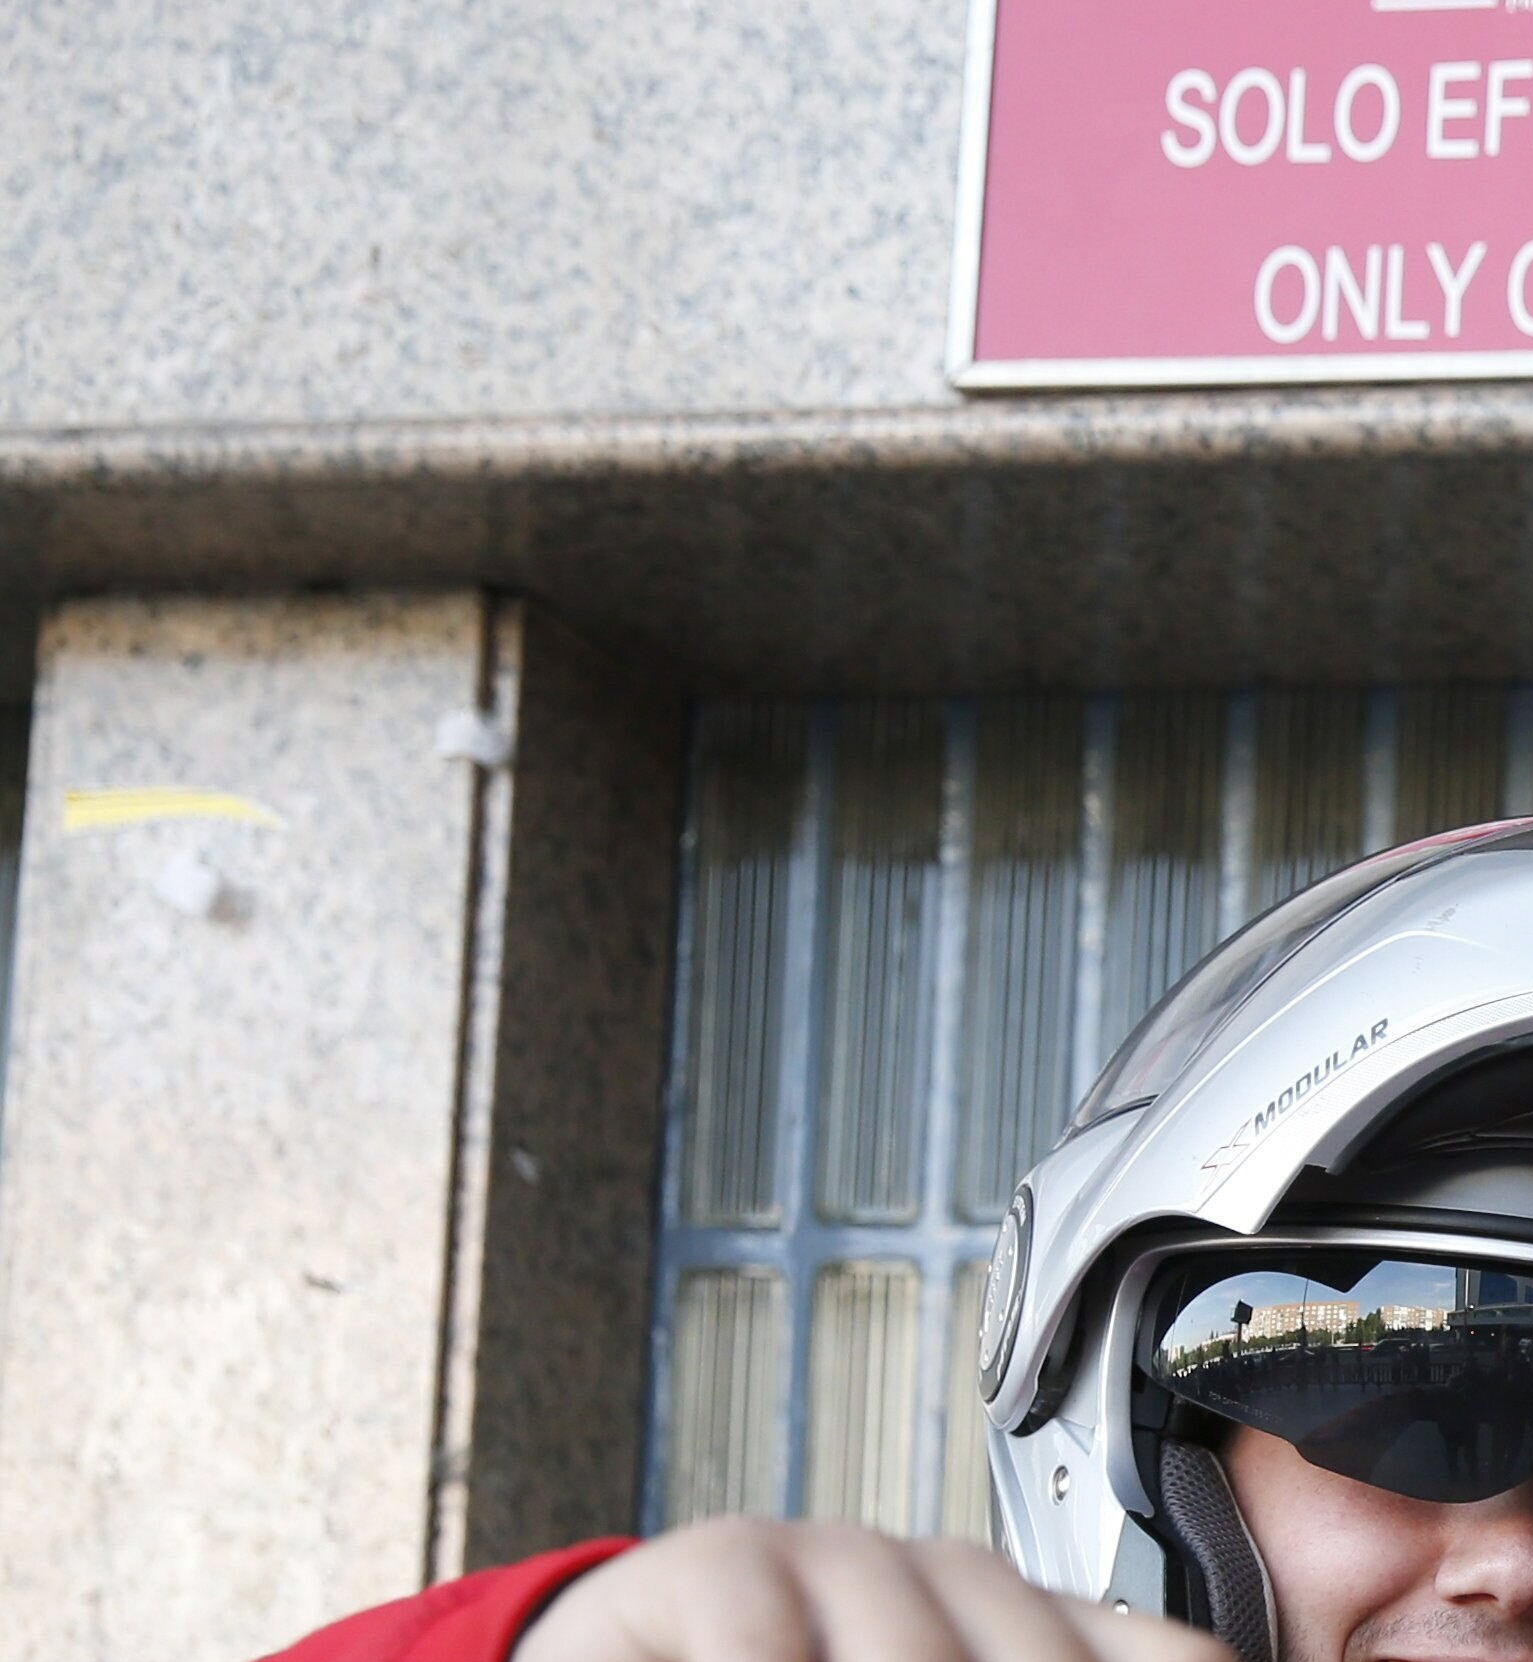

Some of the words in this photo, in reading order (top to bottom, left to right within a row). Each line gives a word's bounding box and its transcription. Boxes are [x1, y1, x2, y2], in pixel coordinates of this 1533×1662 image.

[1160, 63, 1402, 168] SOLO
[1253, 240, 1488, 345] ONLY
[1253, 1017, 1389, 1137] MODULAR
